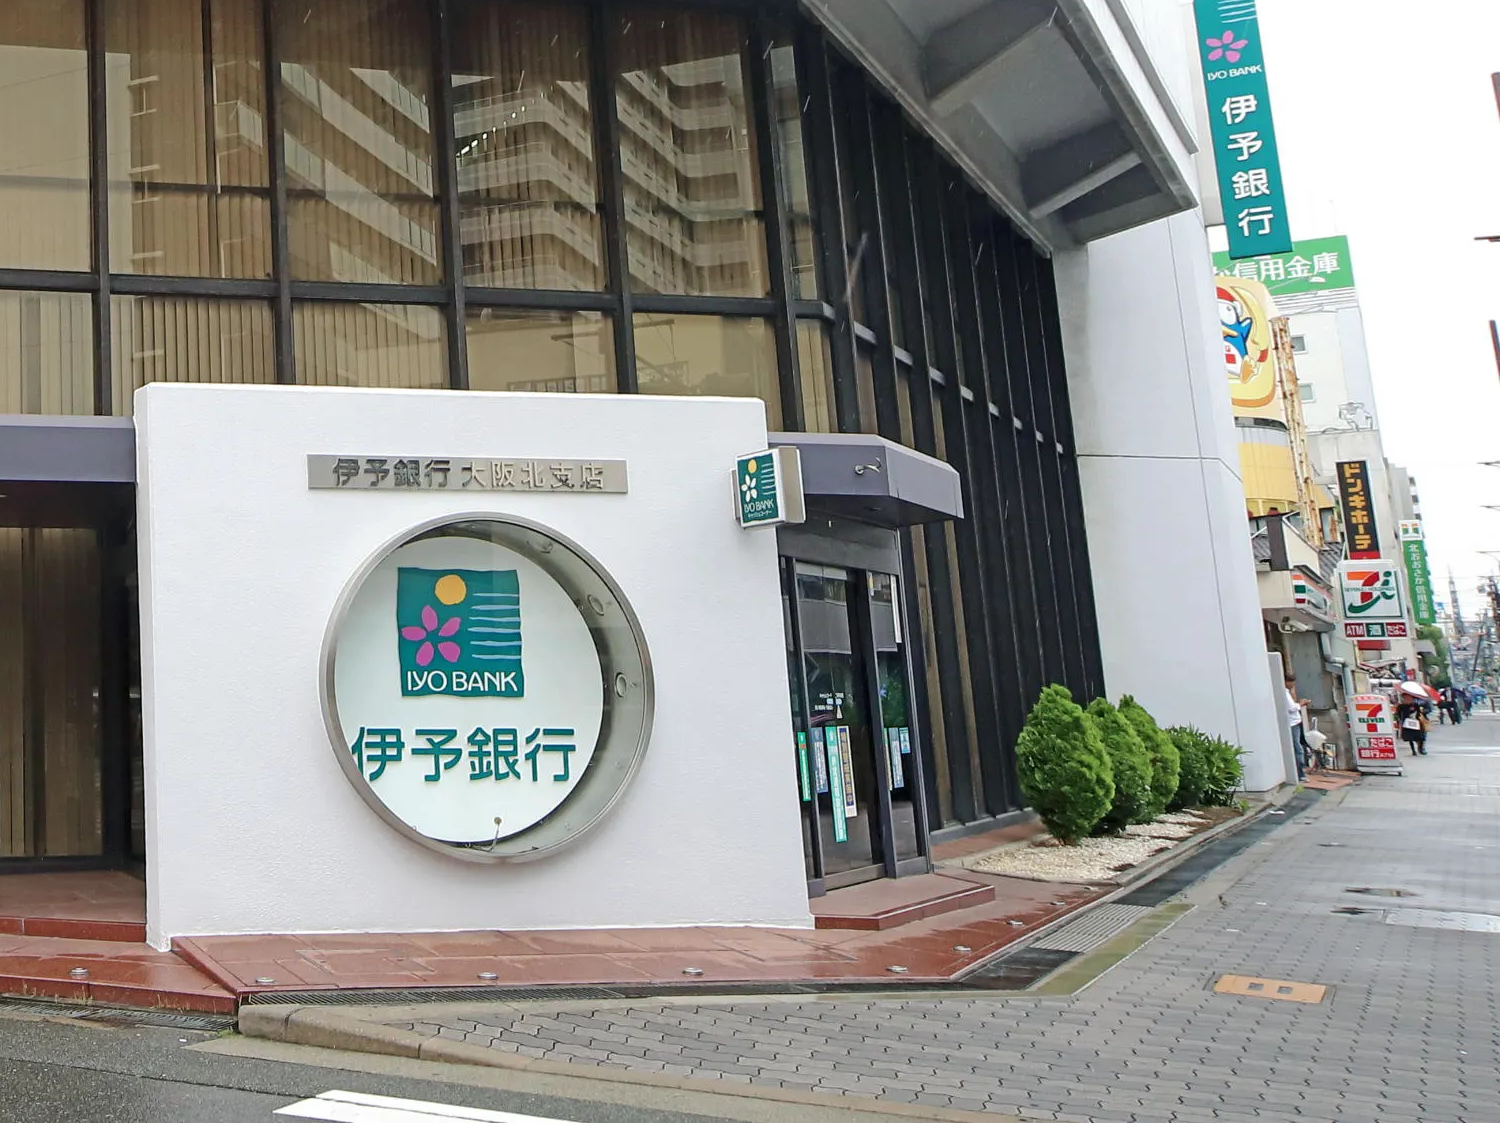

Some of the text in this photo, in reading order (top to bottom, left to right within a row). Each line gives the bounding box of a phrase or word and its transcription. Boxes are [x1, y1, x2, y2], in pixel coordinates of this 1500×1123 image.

[1207, 64, 1263, 81] IYO BANK
[1221, 94, 1275, 237] 伊予銀行
[332, 458, 604, 491] 伊予銀行 大阪北支店
[755, 498, 775, 511] BANK
[1346, 625, 1365, 636] ATM
[406, 670, 518, 693] IYO BANK
[351, 726, 577, 783] 伊予銀行
